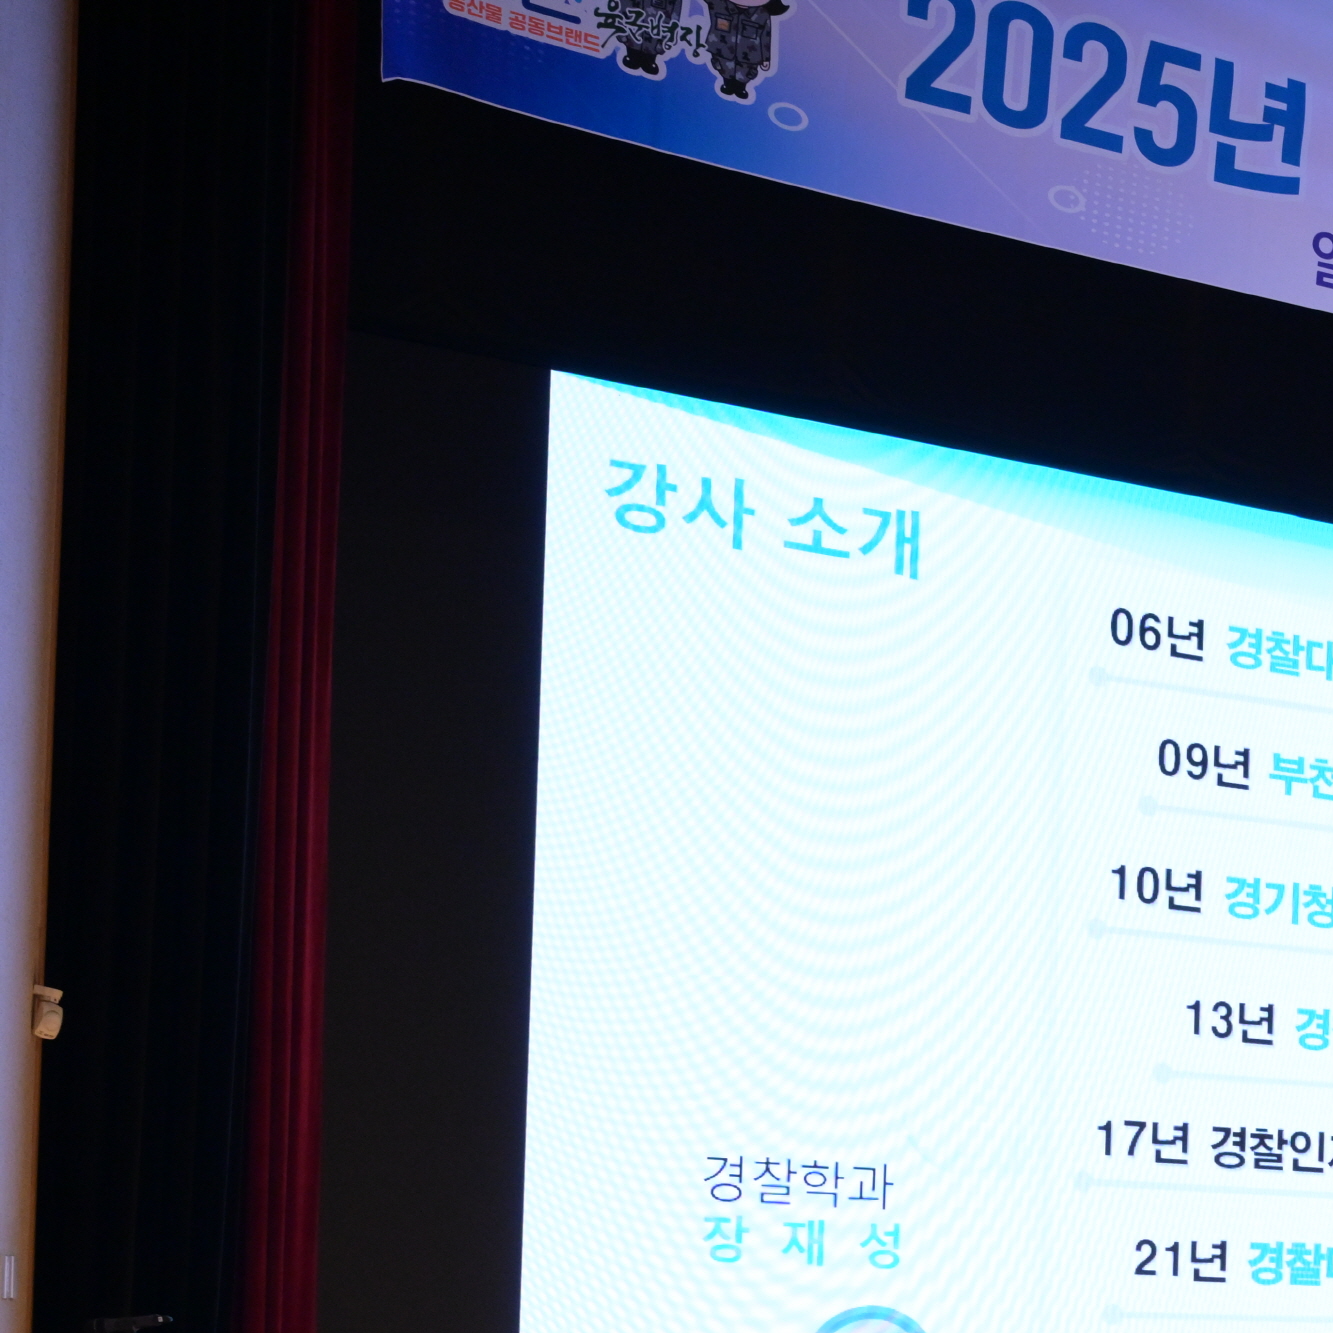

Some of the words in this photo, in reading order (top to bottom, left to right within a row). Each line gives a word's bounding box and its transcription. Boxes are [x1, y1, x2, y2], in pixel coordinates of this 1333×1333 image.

[509, 10, 600, 53] 공동브랜드
[904, 0, 1306, 195] 2025년
[605, 459, 755, 550] 강사
[784, 497, 920, 580] 소개
[1111, 608, 1205, 662] 06년
[1158, 739, 1251, 791] 09년
[1111, 864, 1203, 913] 10년
[1187, 1000, 1275, 1046] 13년
[1098, 1120, 1190, 1165] 17년
[704, 1155, 894, 1210] 경찰학과
[702, 1215, 750, 1263] 장
[782, 1219, 825, 1266] 재
[859, 1223, 900, 1270] 성
[1134, 1239, 1229, 1284] 21년
